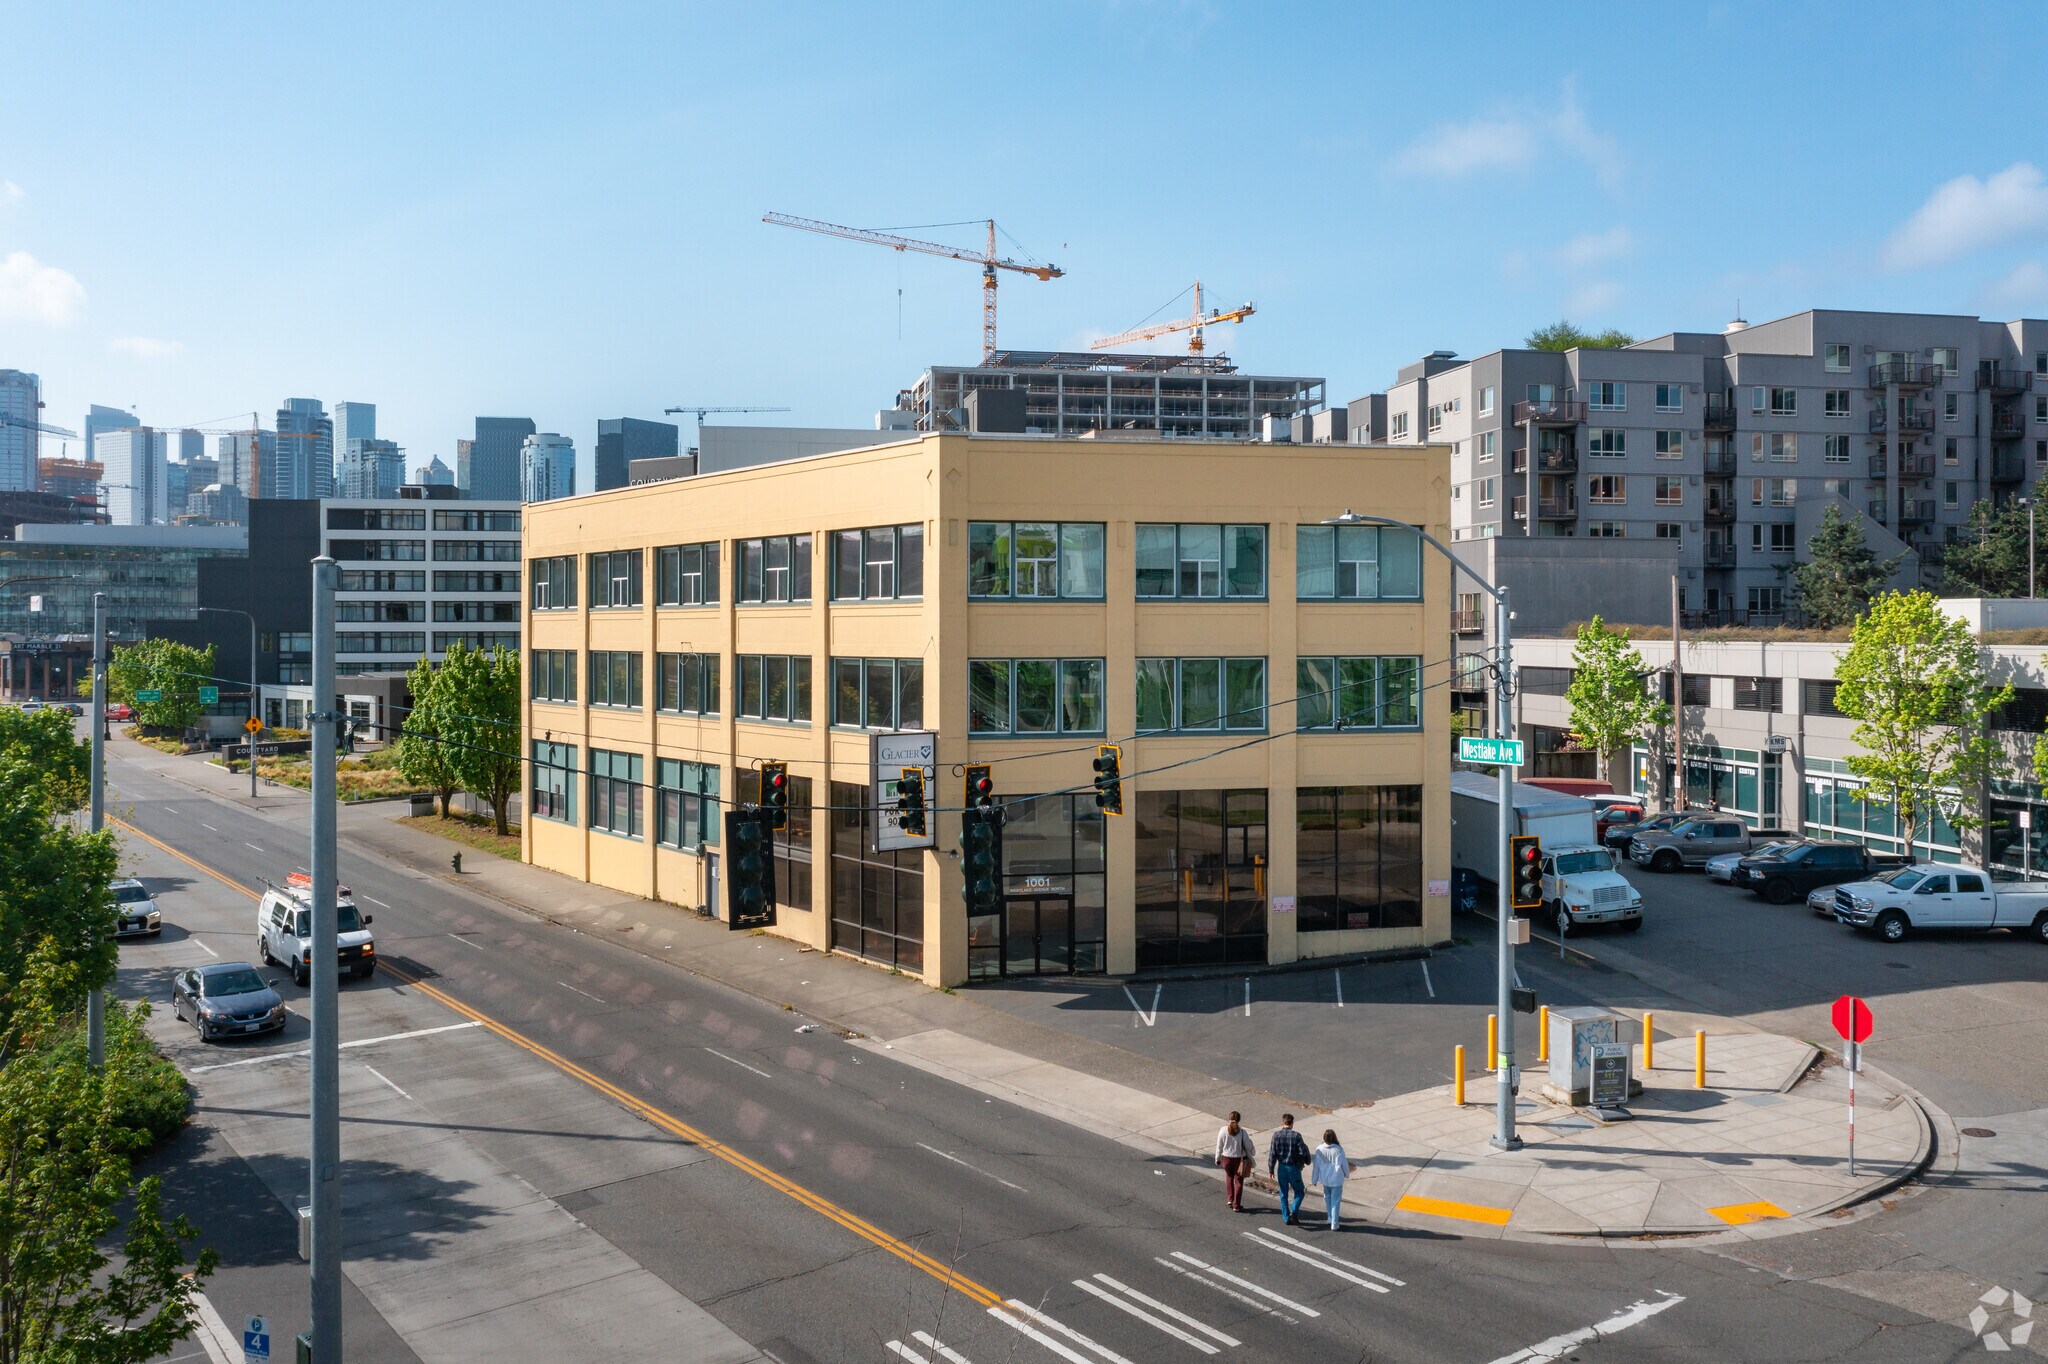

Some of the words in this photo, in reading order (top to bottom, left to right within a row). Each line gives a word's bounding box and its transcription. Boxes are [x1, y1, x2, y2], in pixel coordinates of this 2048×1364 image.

[881, 747, 920, 760] GLACIER
[1463, 741, 1496, 760] Westlake
[1499, 743, 1513, 762] Ave
[1516, 744, 1521, 762] N
[1837, 780, 1860, 789] FITNESS
[1025, 878, 1050, 887] 1001
[251, 1334, 262, 1349] 4
